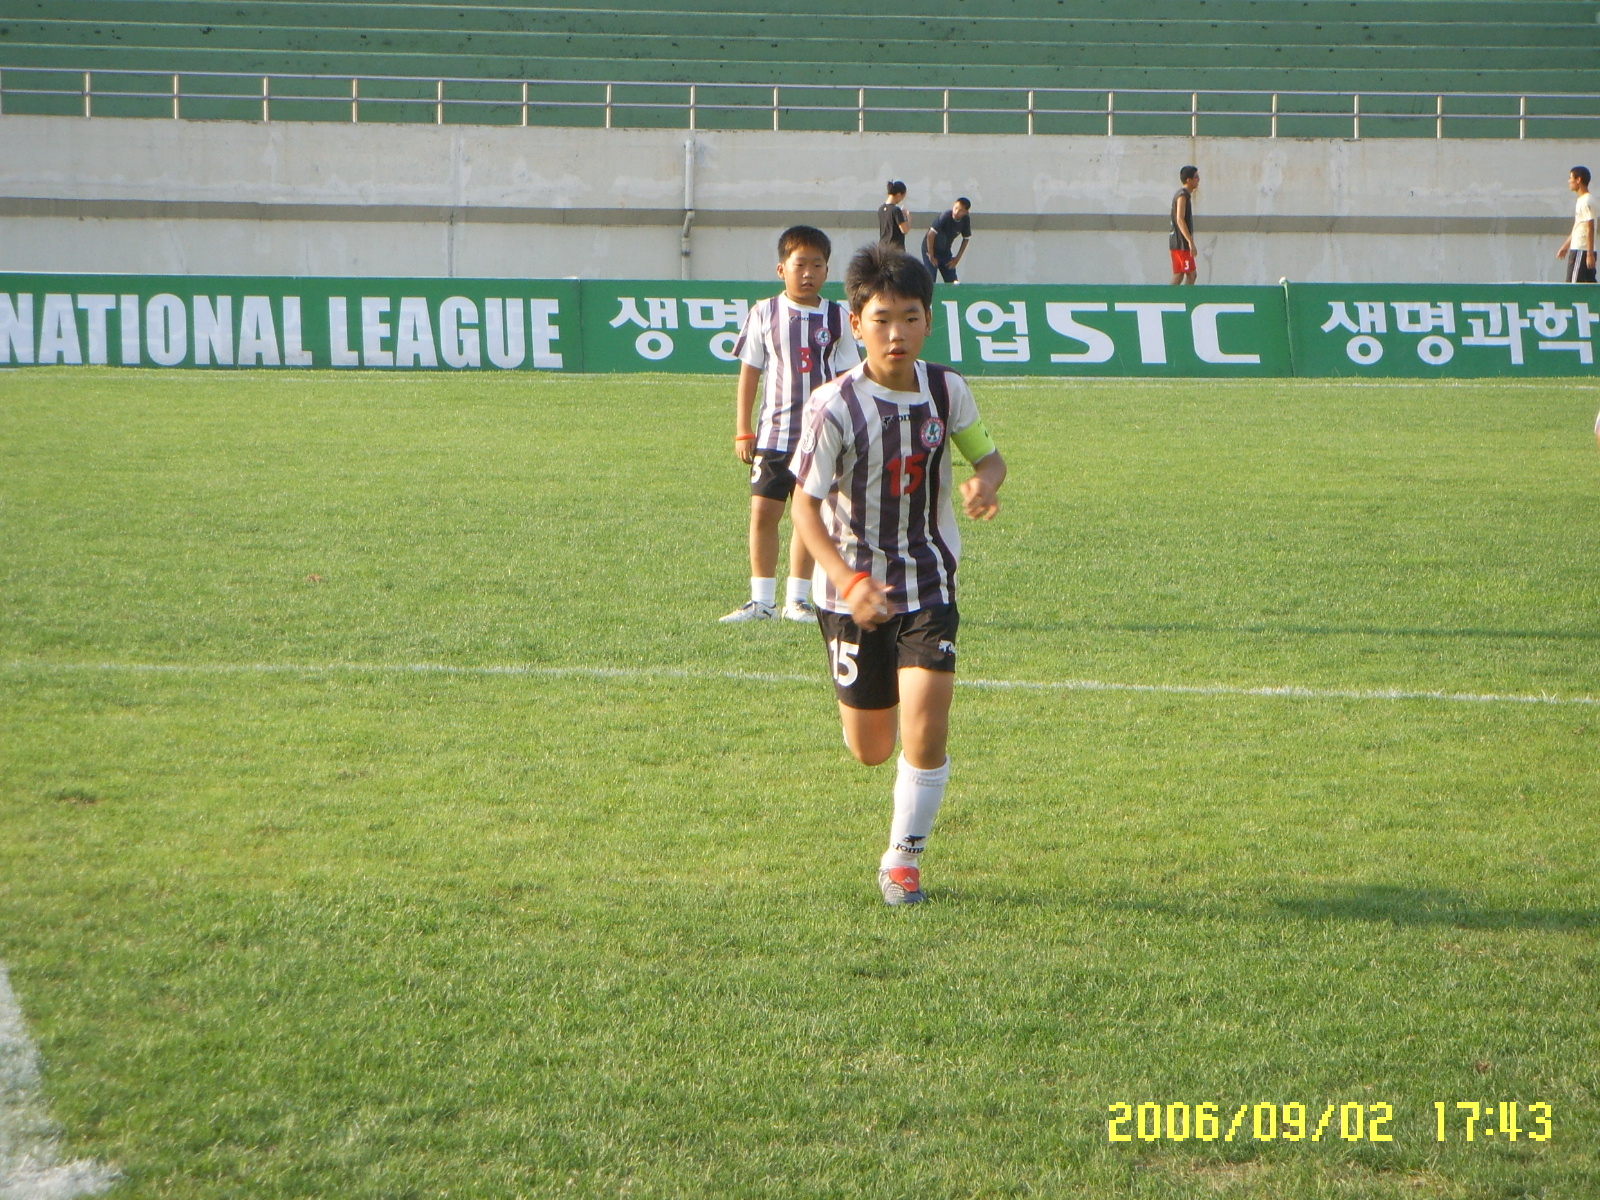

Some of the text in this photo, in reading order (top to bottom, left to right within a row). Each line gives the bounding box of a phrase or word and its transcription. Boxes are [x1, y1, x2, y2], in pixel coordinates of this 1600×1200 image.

[1184, 260, 1190, 270] 3
[0, 293, 563, 369] NATIONAL LEAGUE
[1320, 301, 1600, 365] 생명과학
[798, 347, 814, 373] 3
[751, 455, 764, 484] 3
[887, 452, 926, 497] 15
[829, 637, 860, 687] 15
